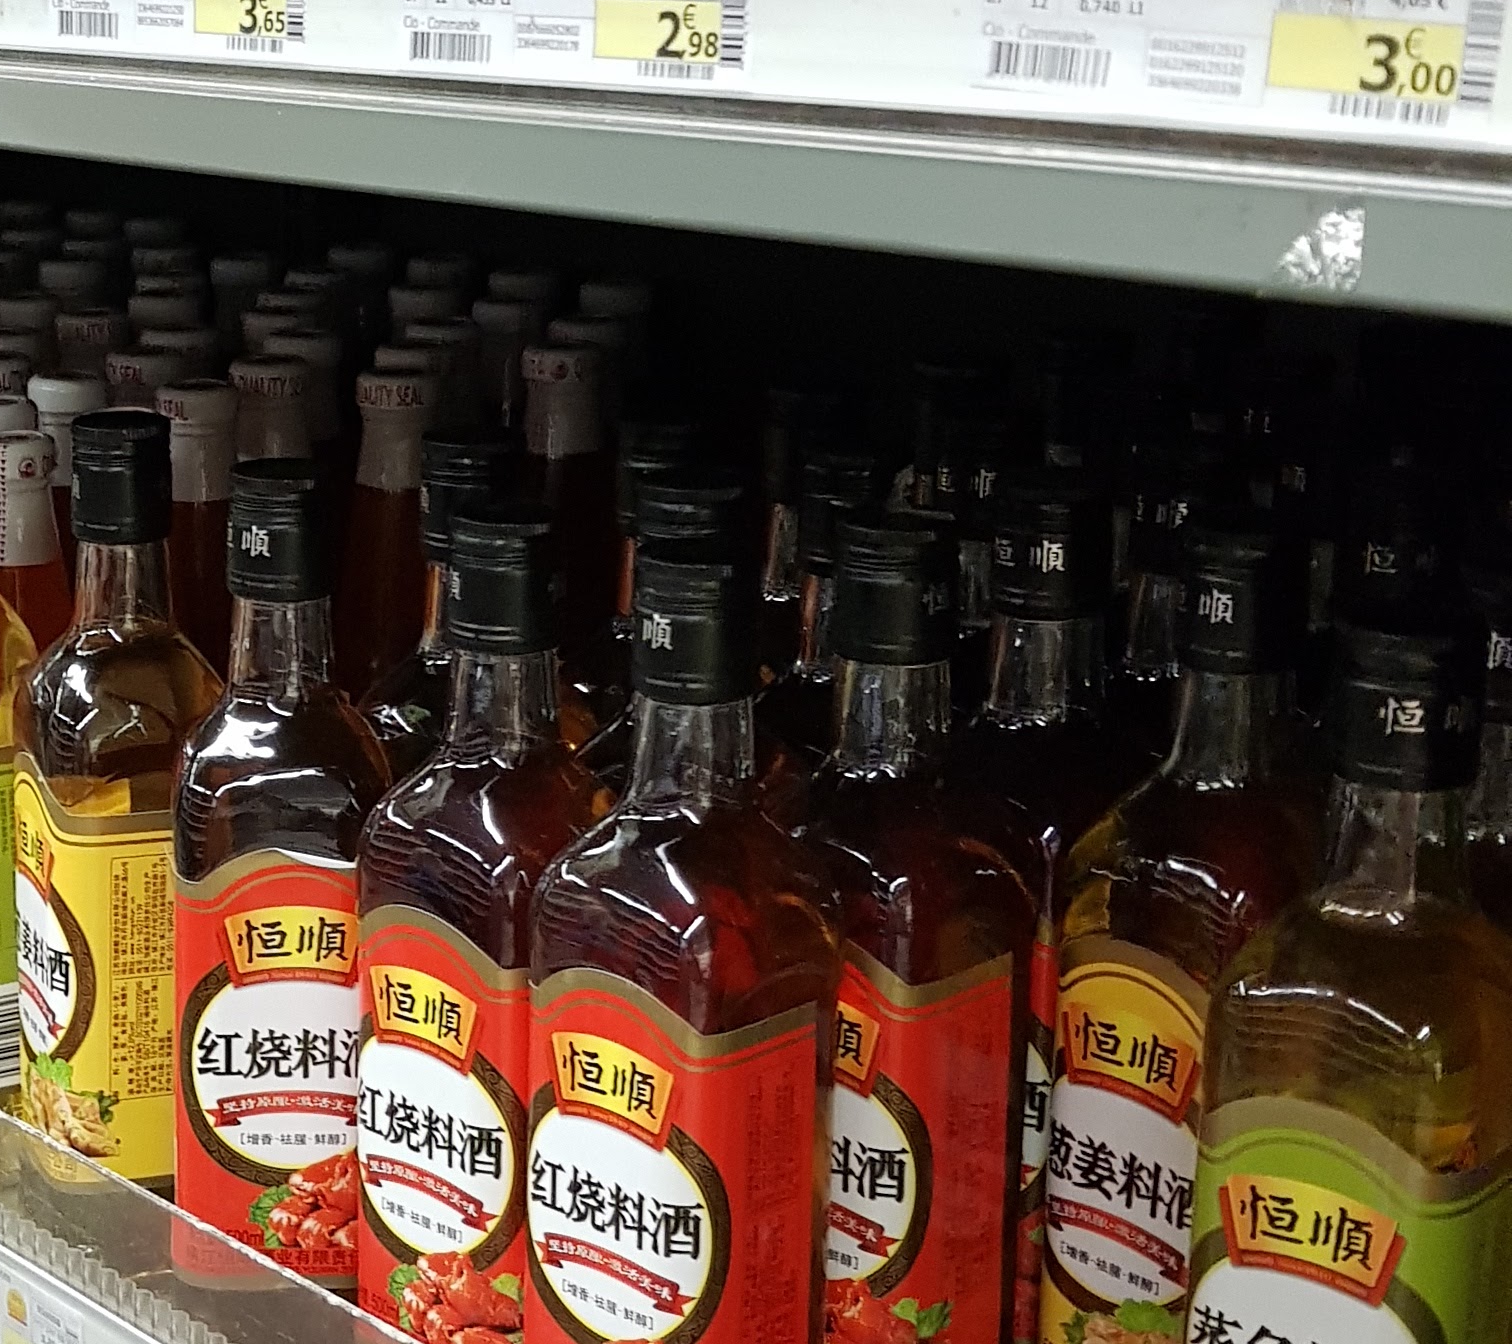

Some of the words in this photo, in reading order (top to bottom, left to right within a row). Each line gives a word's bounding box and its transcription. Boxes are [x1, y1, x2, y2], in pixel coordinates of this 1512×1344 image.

[427, 16, 481, 31] Commande
[1019, 25, 1097, 46] Commande
[396, 384, 425, 407] SEAL
[530, 1155, 704, 1261] 红烧料酒
